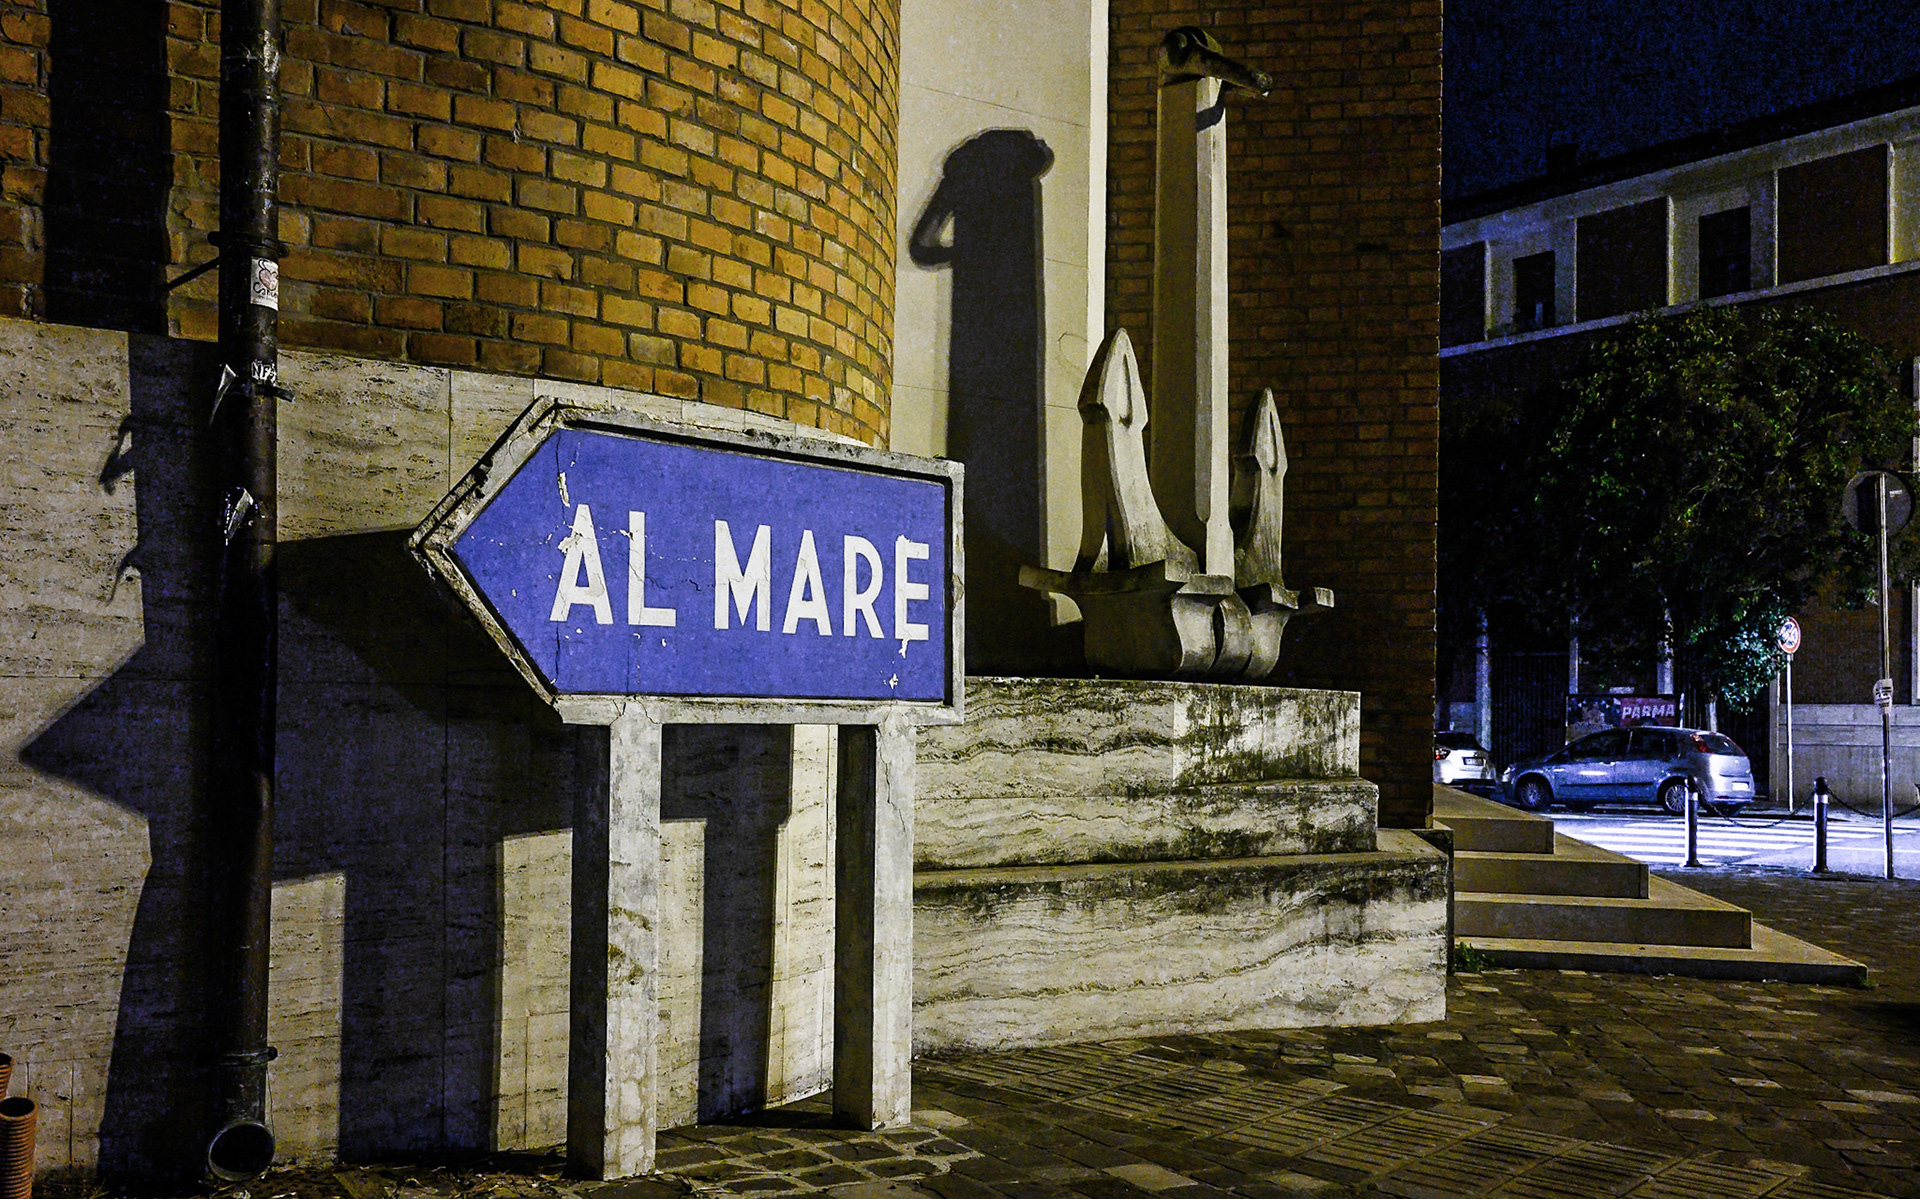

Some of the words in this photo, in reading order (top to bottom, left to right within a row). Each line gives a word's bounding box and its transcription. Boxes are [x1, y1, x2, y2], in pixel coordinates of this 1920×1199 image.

[550, 503, 676, 627] AL
[714, 519, 930, 641] MARE
[1622, 704, 1675, 719] PARMA
